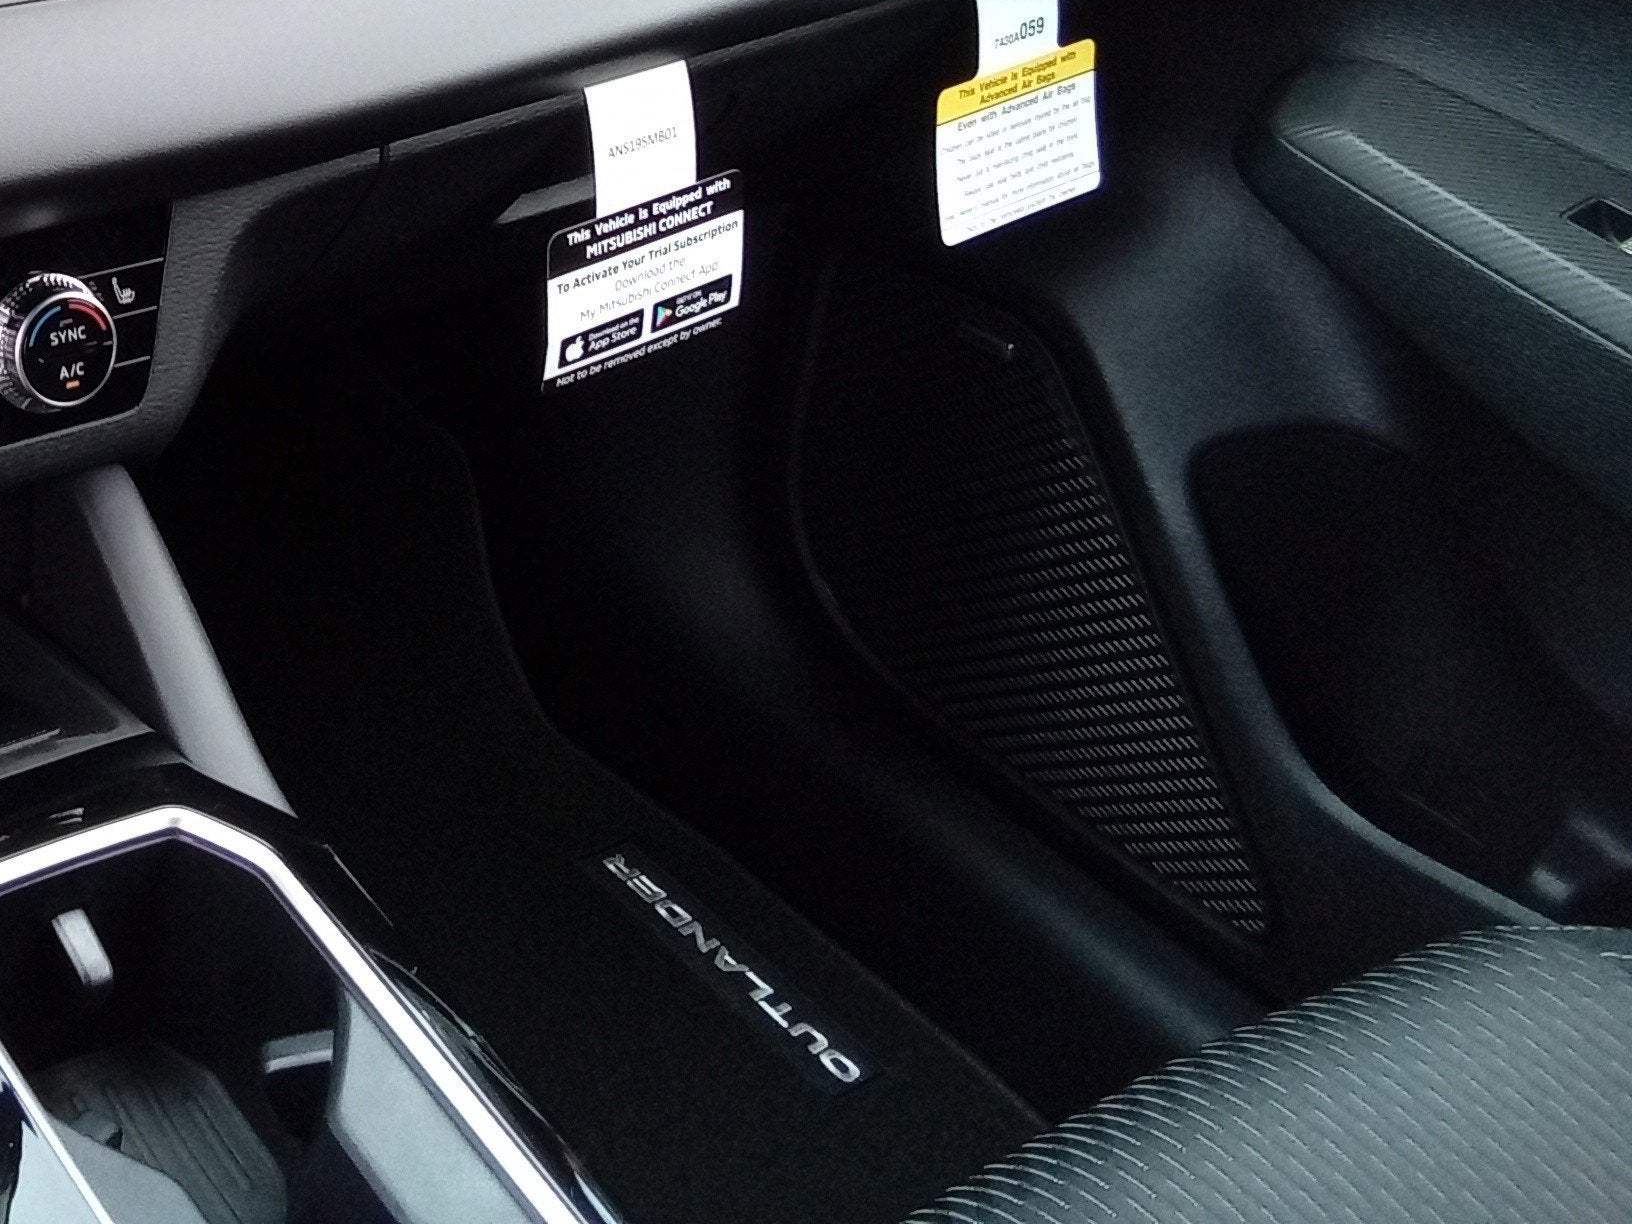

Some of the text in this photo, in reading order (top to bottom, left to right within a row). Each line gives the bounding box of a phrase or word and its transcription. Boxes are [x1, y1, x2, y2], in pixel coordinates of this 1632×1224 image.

[567, 177, 731, 246] This Vehicle is Equipped with
[586, 201, 714, 259] MITSUBISHI CONNECT
[557, 220, 738, 294] To Activate Your Trial Subscription
[49, 325, 87, 347] SYNC
[60, 361, 85, 380] A/C
[602, 854, 861, 1082] OUTLANDER
